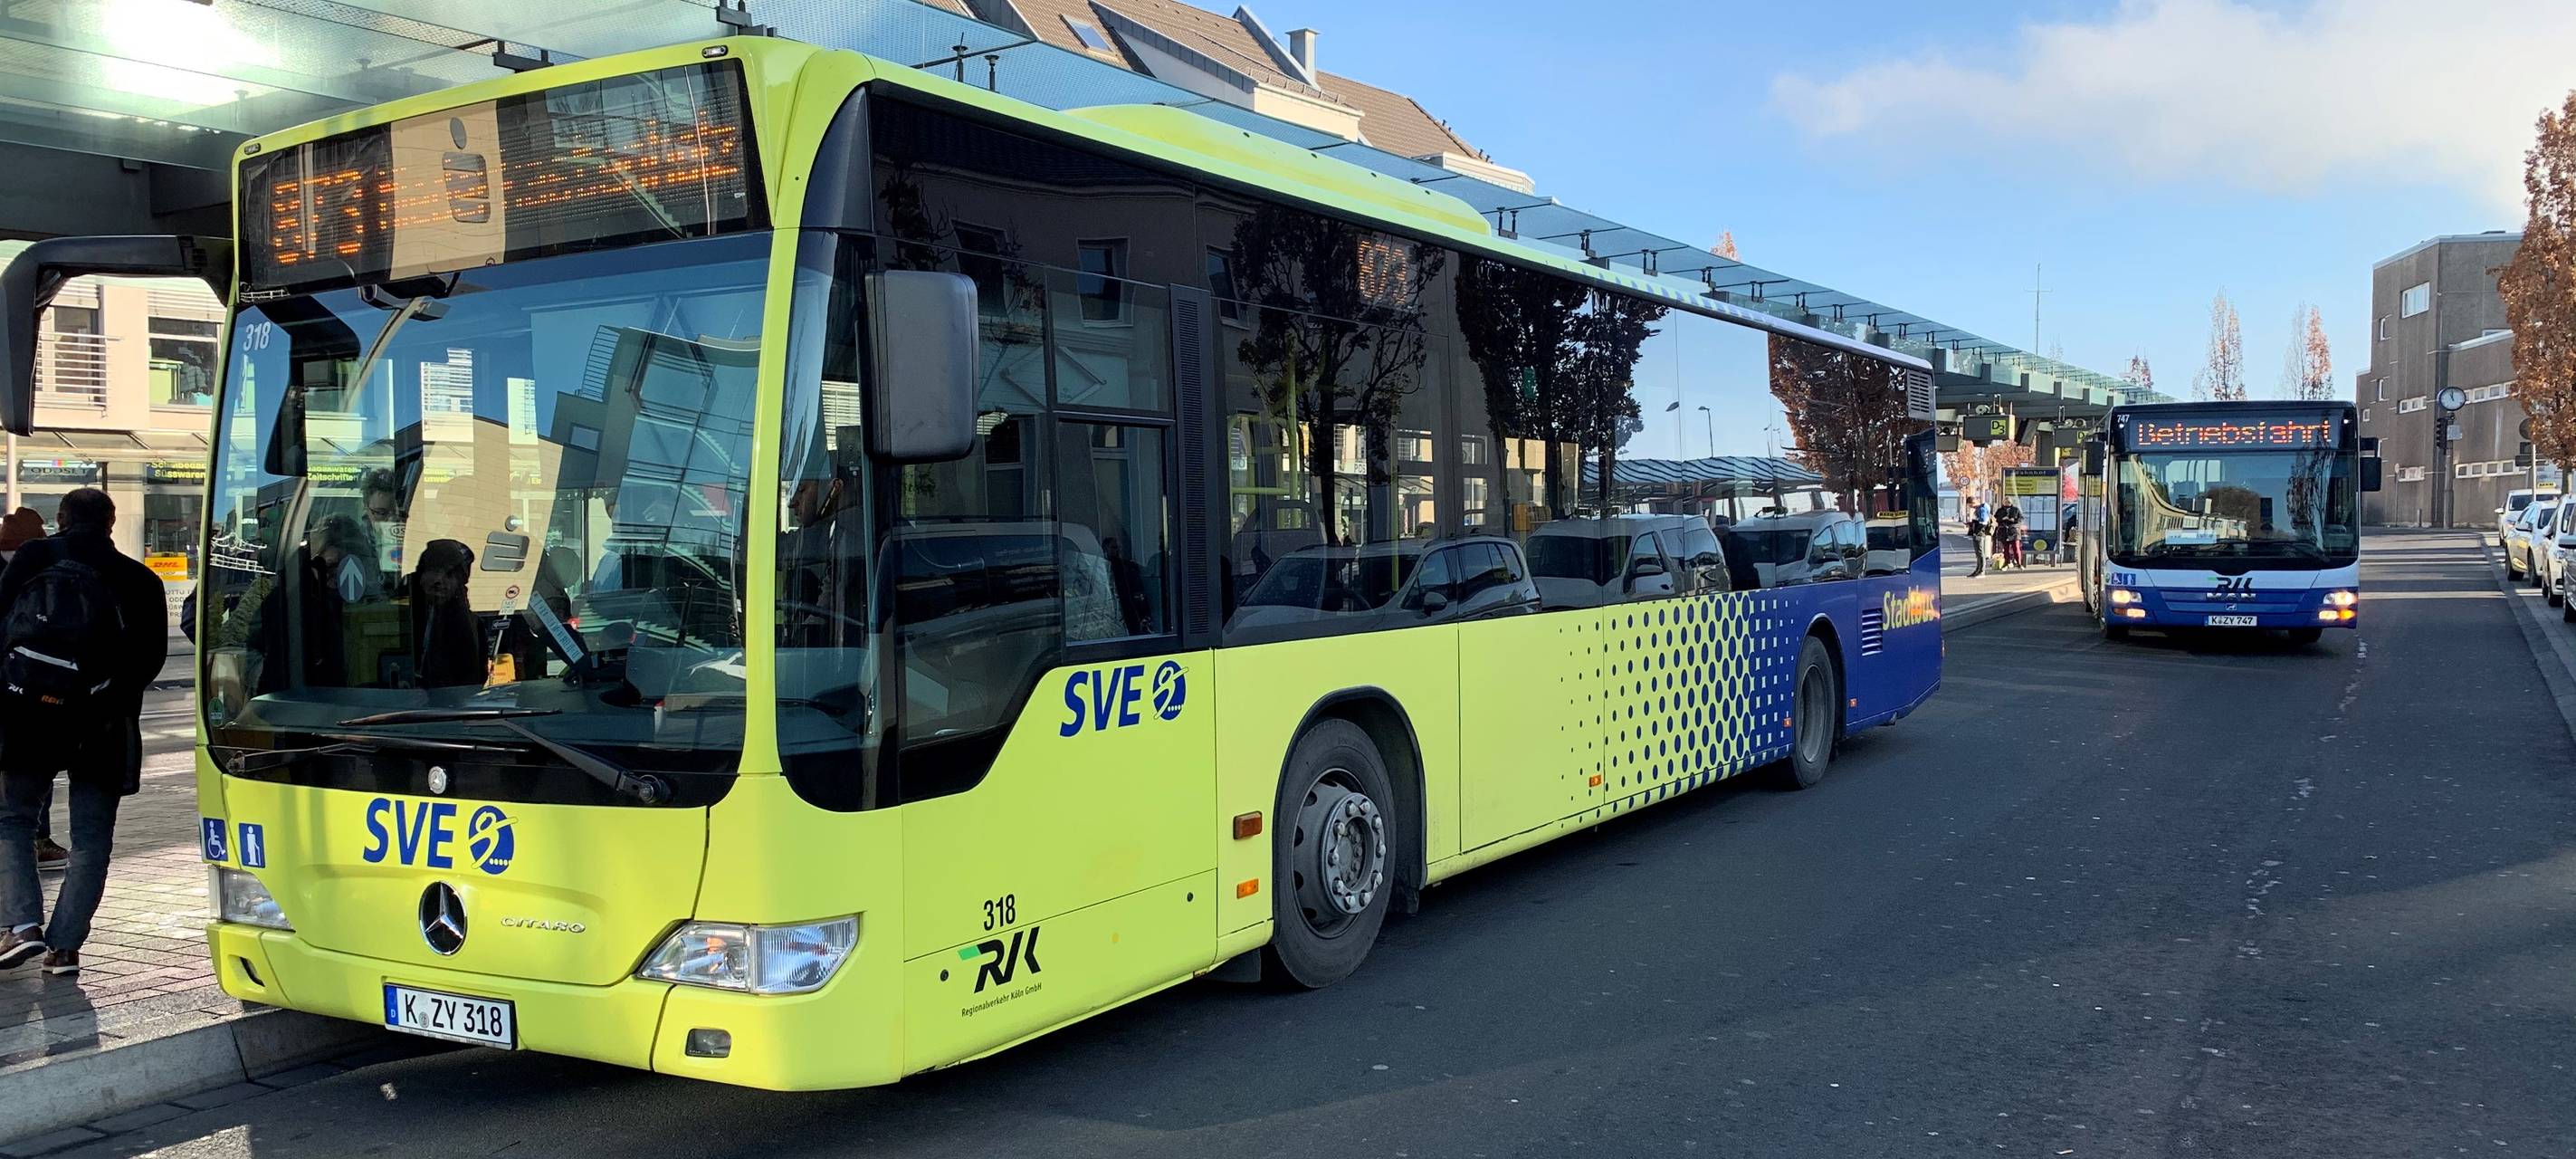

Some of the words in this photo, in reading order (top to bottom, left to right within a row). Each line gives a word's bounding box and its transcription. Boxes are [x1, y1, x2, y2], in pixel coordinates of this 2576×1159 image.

[272, 169, 364, 265] 873
[243, 321, 272, 353] 318
[2116, 414, 2130, 423] 747
[2212, 617, 2218, 625] K
[2223, 617, 2235, 625] ZY
[2237, 617, 2254, 625] 747
[1059, 665, 1145, 738] SVE
[362, 798, 457, 869] SVE
[500, 915, 587, 934] CITARO
[983, 893, 1016, 932] 318
[405, 993, 418, 1024] K
[431, 998, 457, 1030] ZY
[463, 1002, 503, 1038] 318
[961, 994, 1009, 1017] Regionalverkehr
[1010, 990, 1024, 1000] Köln
[1025, 982, 1042, 995] GmbH
